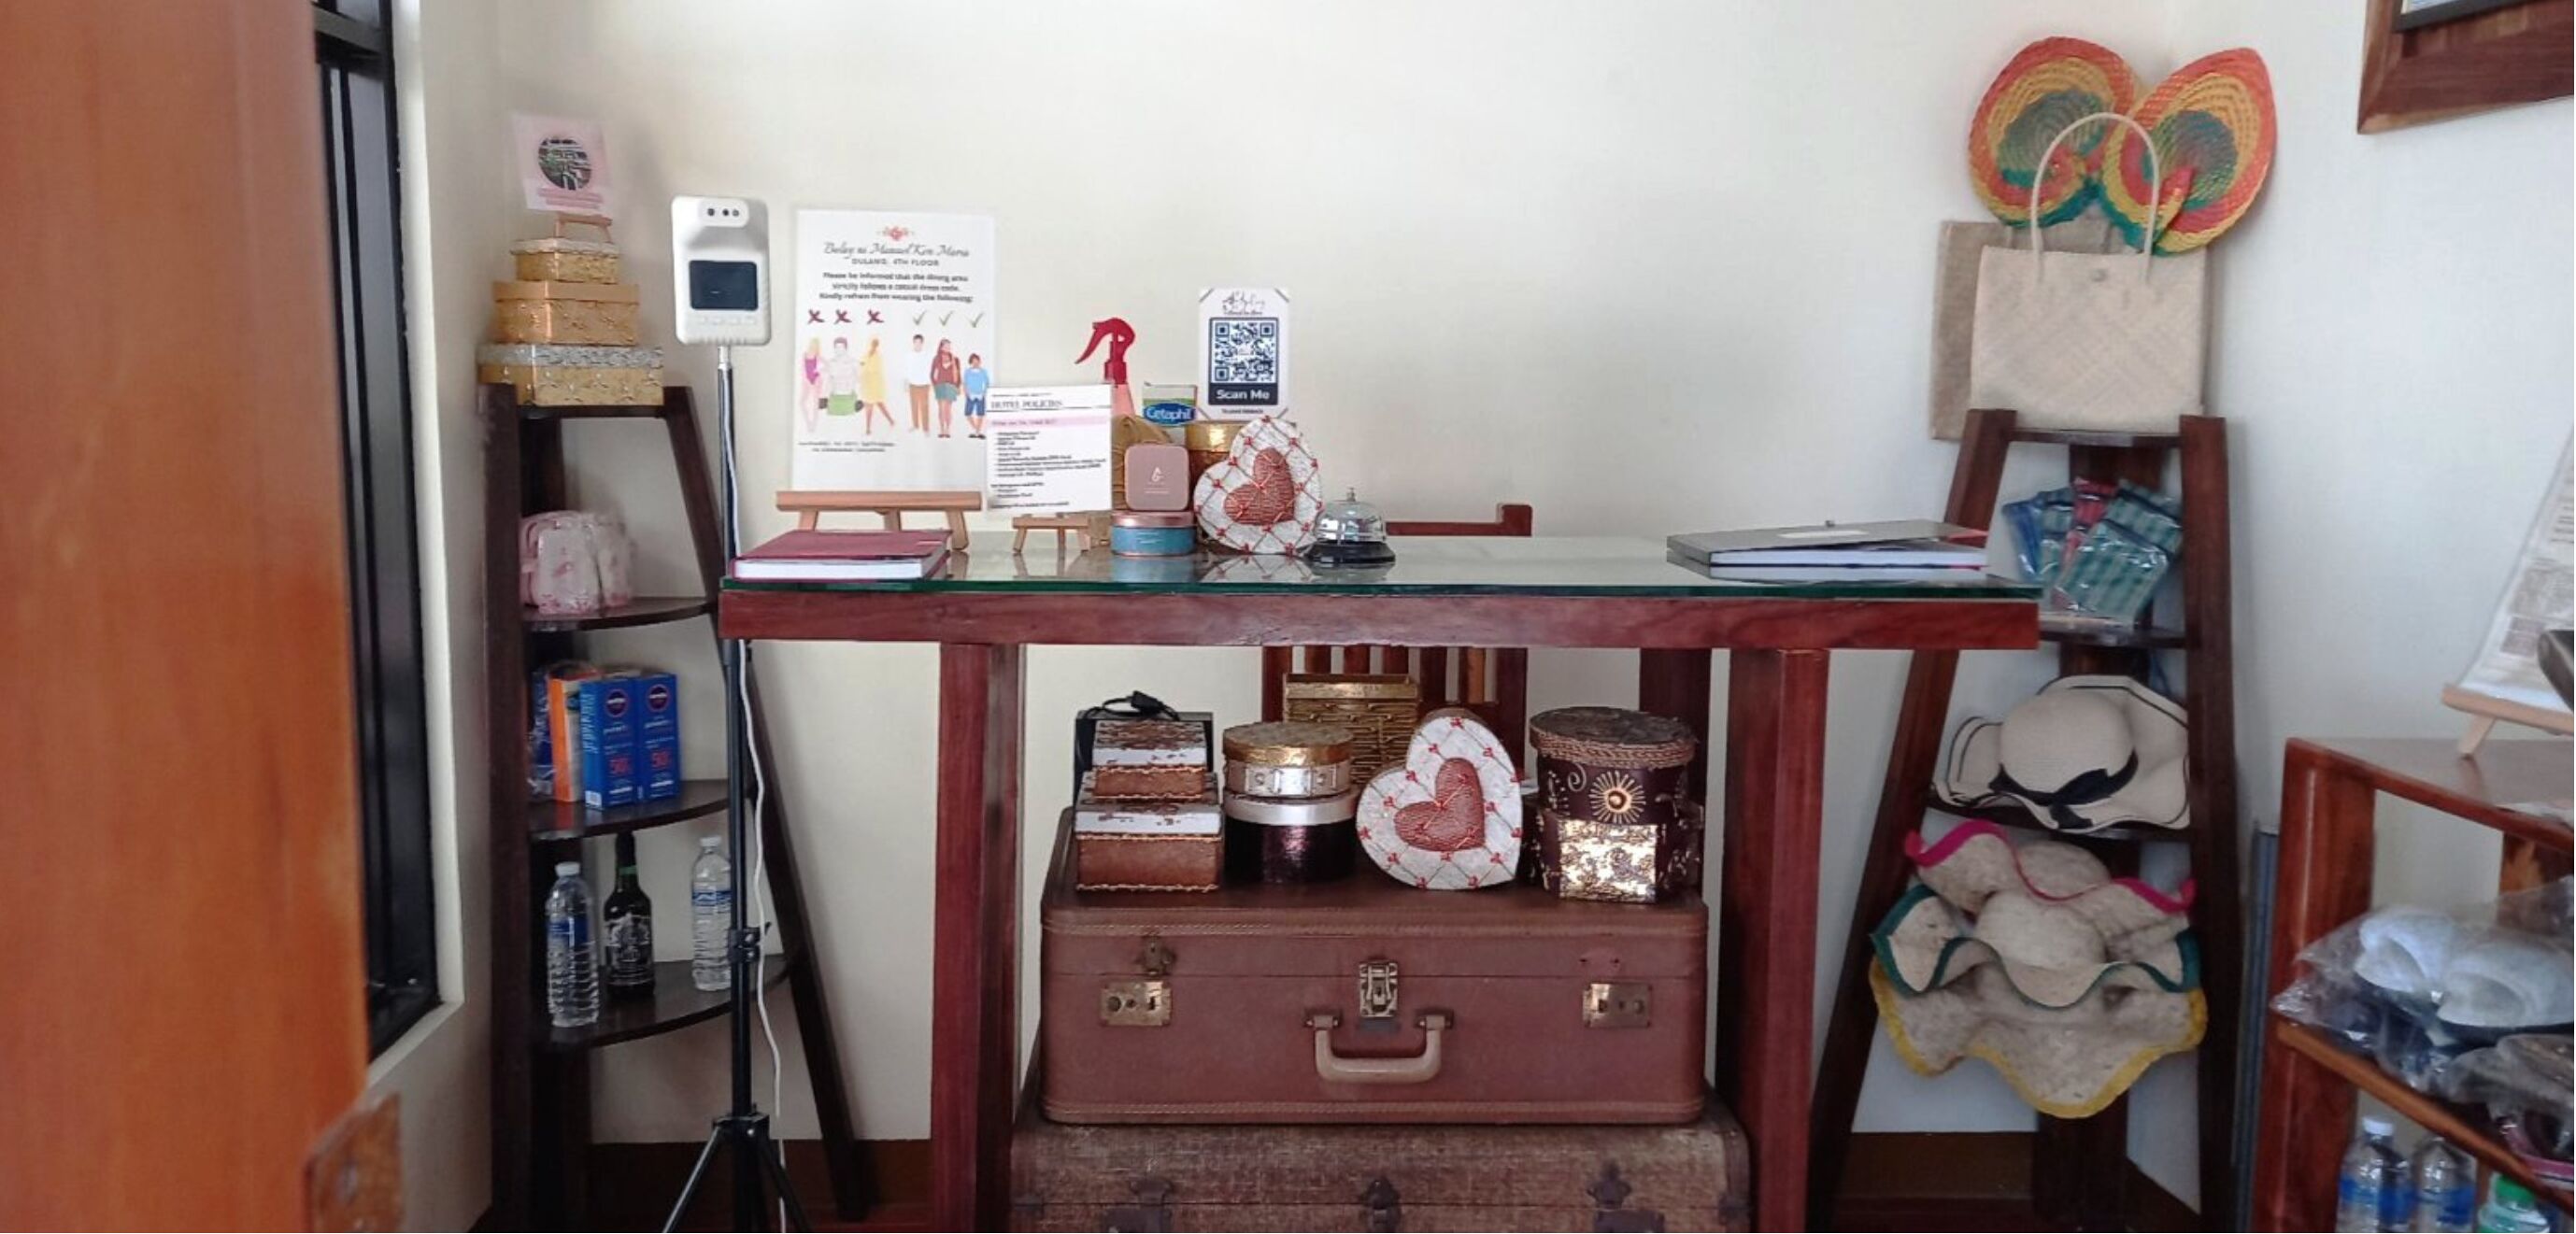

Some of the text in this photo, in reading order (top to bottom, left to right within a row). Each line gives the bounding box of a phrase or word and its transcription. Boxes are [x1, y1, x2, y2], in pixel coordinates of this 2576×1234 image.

[927, 275, 949, 283] dining
[819, 292, 842, 301] Kindly
[1217, 390, 1270, 399] Scan Me
[1146, 406, 1191, 419] Cetaphil
